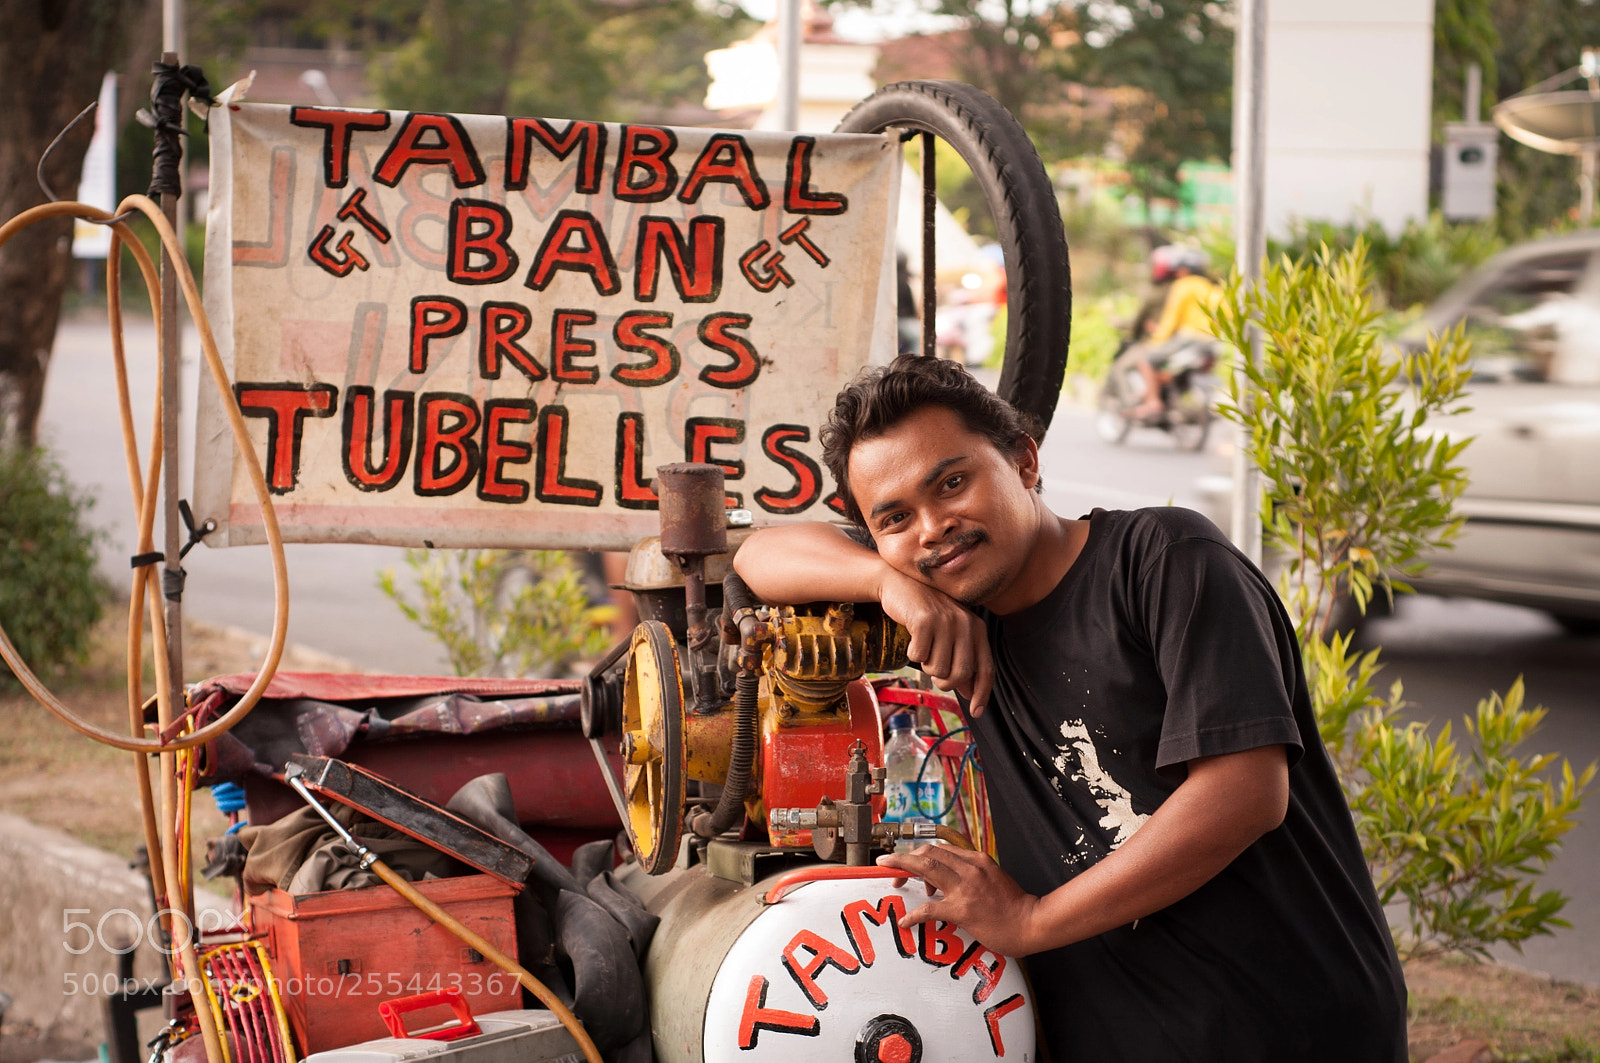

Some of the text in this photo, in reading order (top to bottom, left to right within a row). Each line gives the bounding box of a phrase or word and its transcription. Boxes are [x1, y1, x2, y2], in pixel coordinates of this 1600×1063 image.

[291, 106, 848, 215] TAMBAL
[447, 198, 725, 302] BAN
[409, 296, 760, 389] PRESS
[233, 382, 848, 517] TUBELLES
[738, 895, 1026, 1058] TAMBAL
